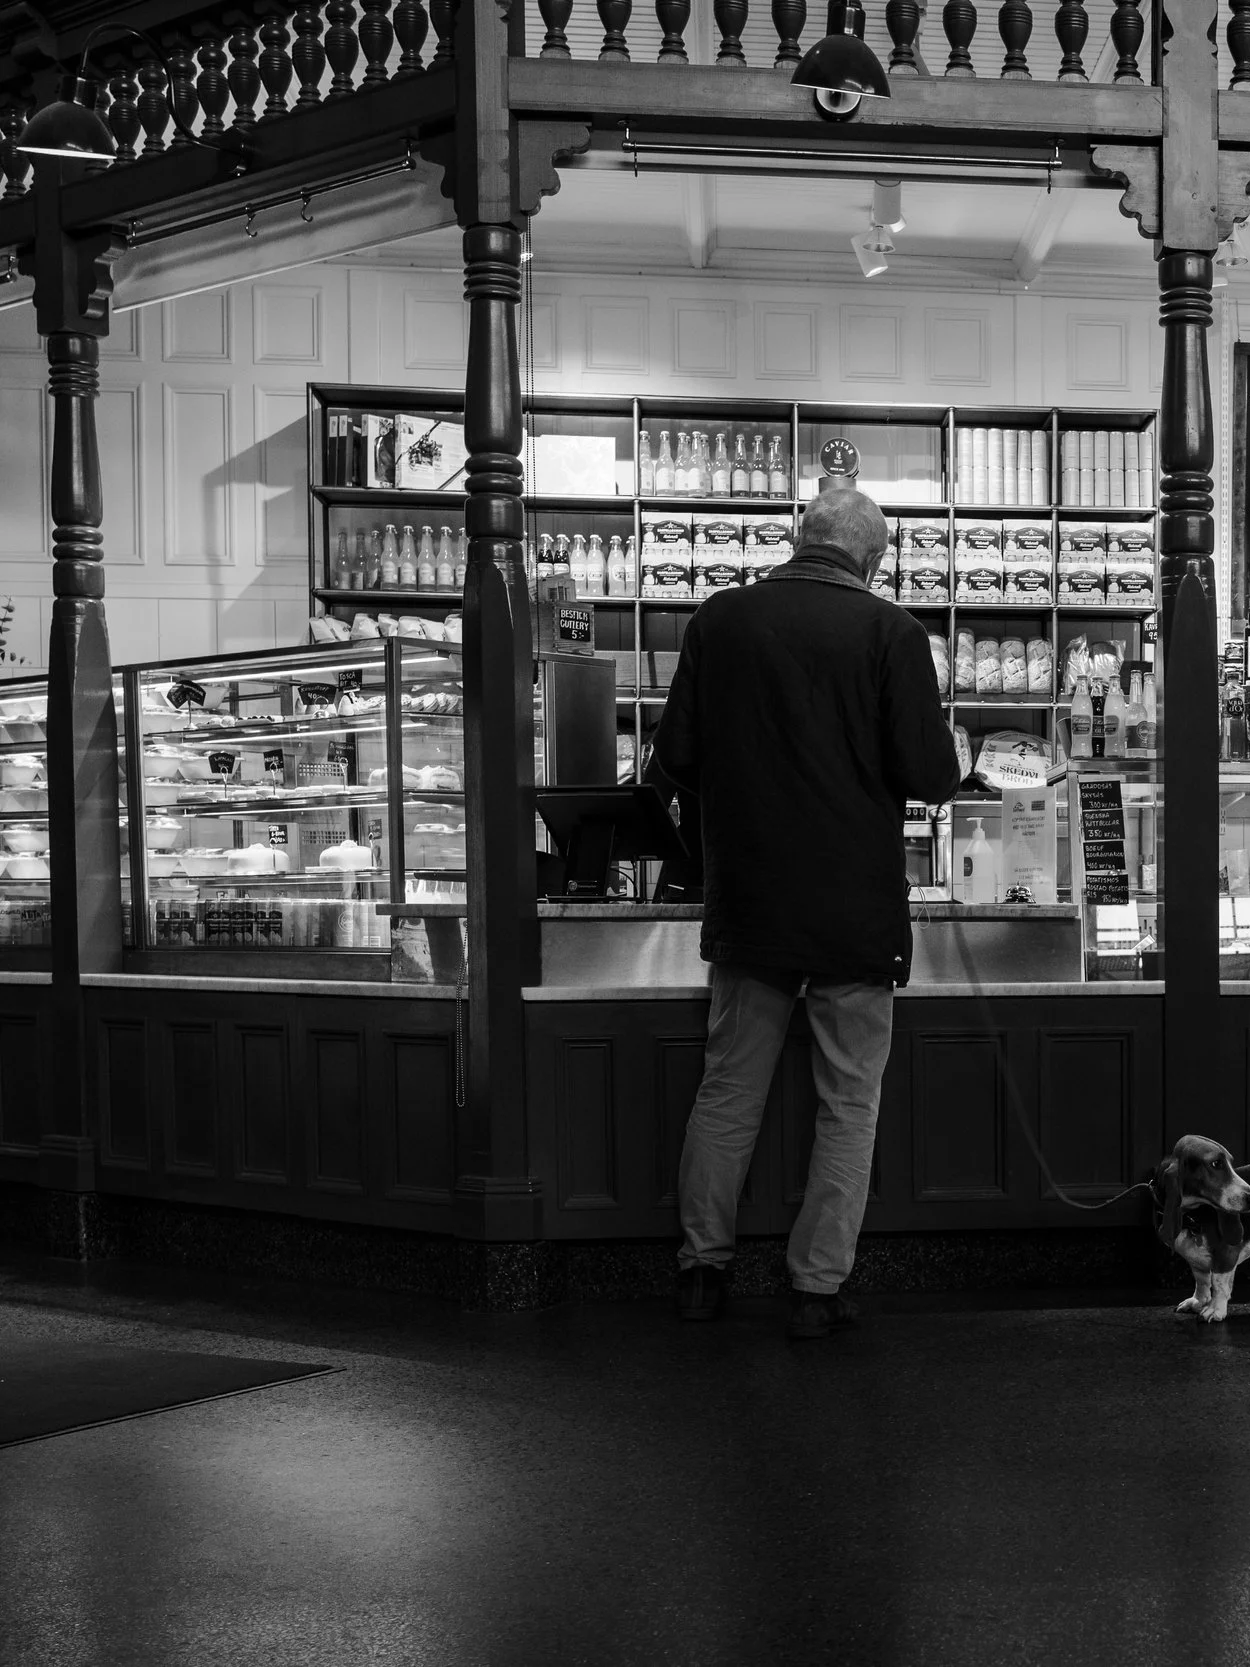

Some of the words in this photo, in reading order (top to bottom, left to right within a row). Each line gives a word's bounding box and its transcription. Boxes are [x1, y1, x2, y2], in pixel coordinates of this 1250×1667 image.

[824, 440, 854, 455] CAVIAR
[560, 609, 588, 621] BESTICK
[560, 619, 589, 631] CUTLERY
[999, 764, 1039, 779] SKEDVI
